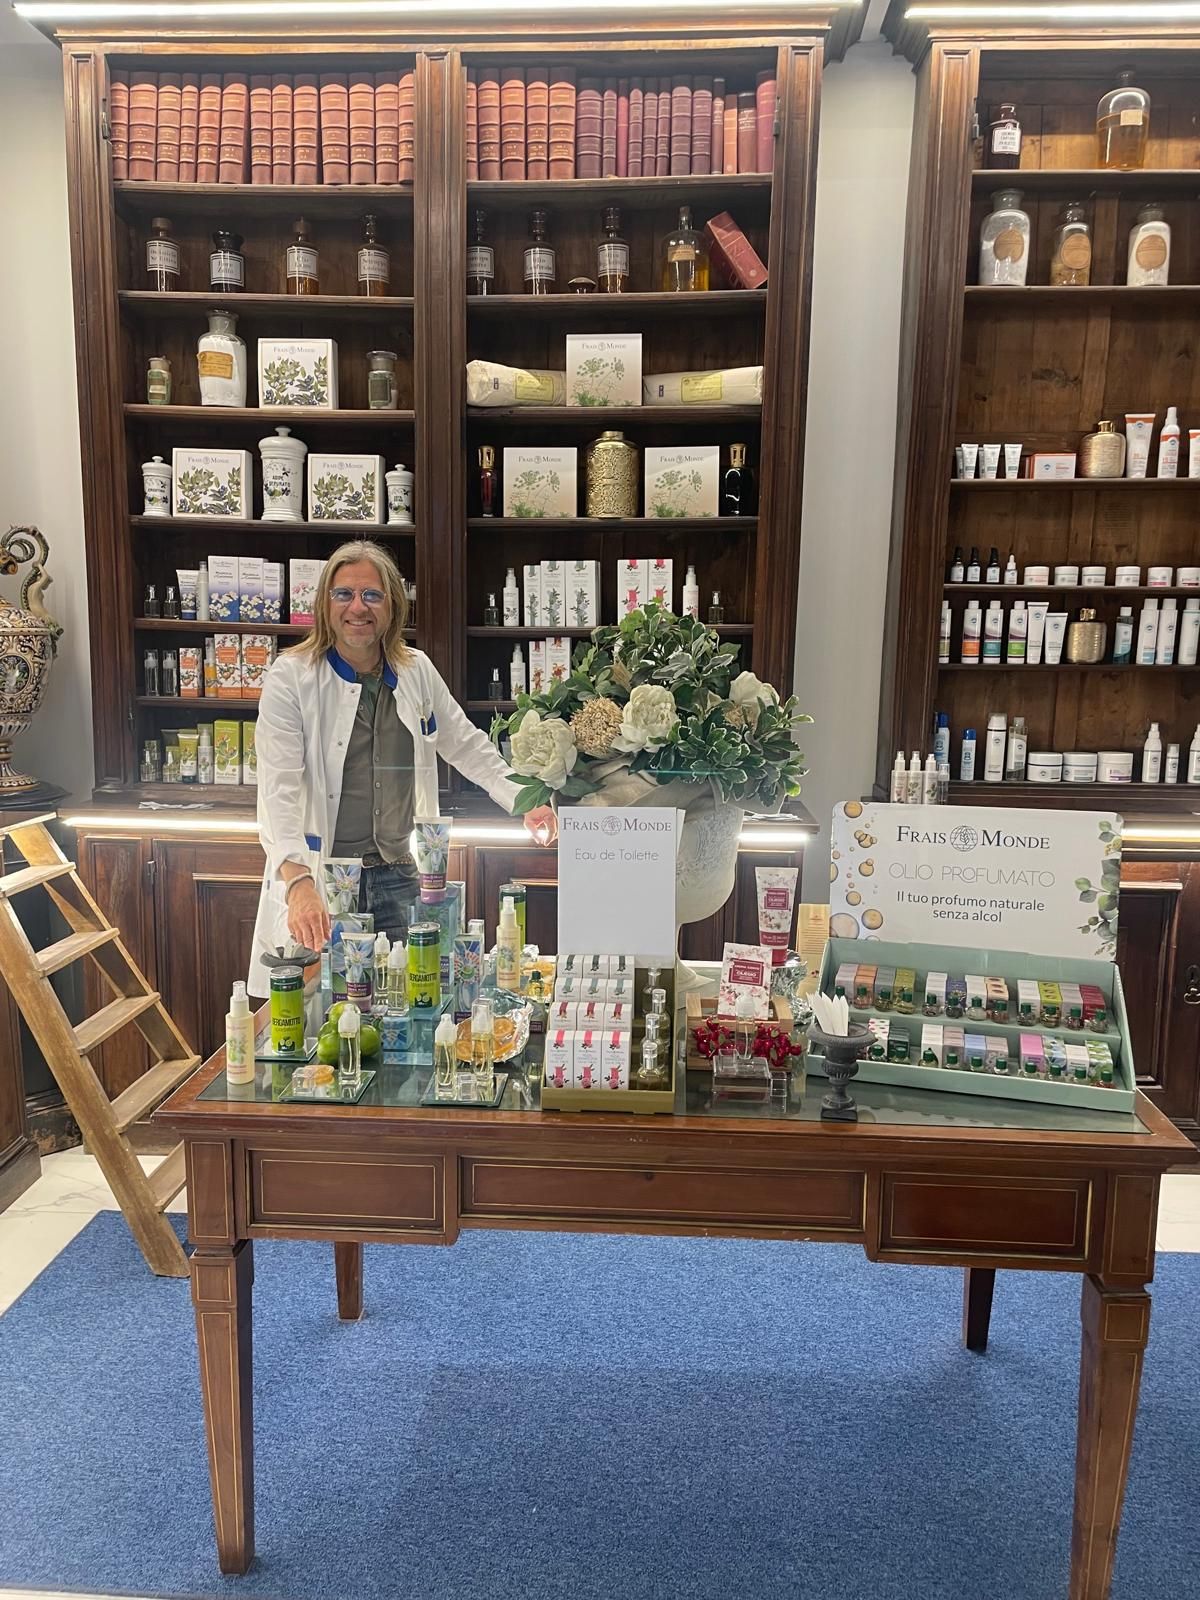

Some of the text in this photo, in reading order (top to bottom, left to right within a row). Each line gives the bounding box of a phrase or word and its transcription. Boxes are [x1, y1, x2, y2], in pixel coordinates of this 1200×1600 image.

[563, 818, 672, 832] FRAIS MONDE
[896, 825, 1050, 849] FRAIS MONDE
[575, 848, 659, 861] Eau de Toilette
[888, 862, 1056, 887] OLIO PROFUMATO
[897, 891, 1045, 910] Il tuo profumo naturale
[933, 909, 1002, 922] senza alcol
